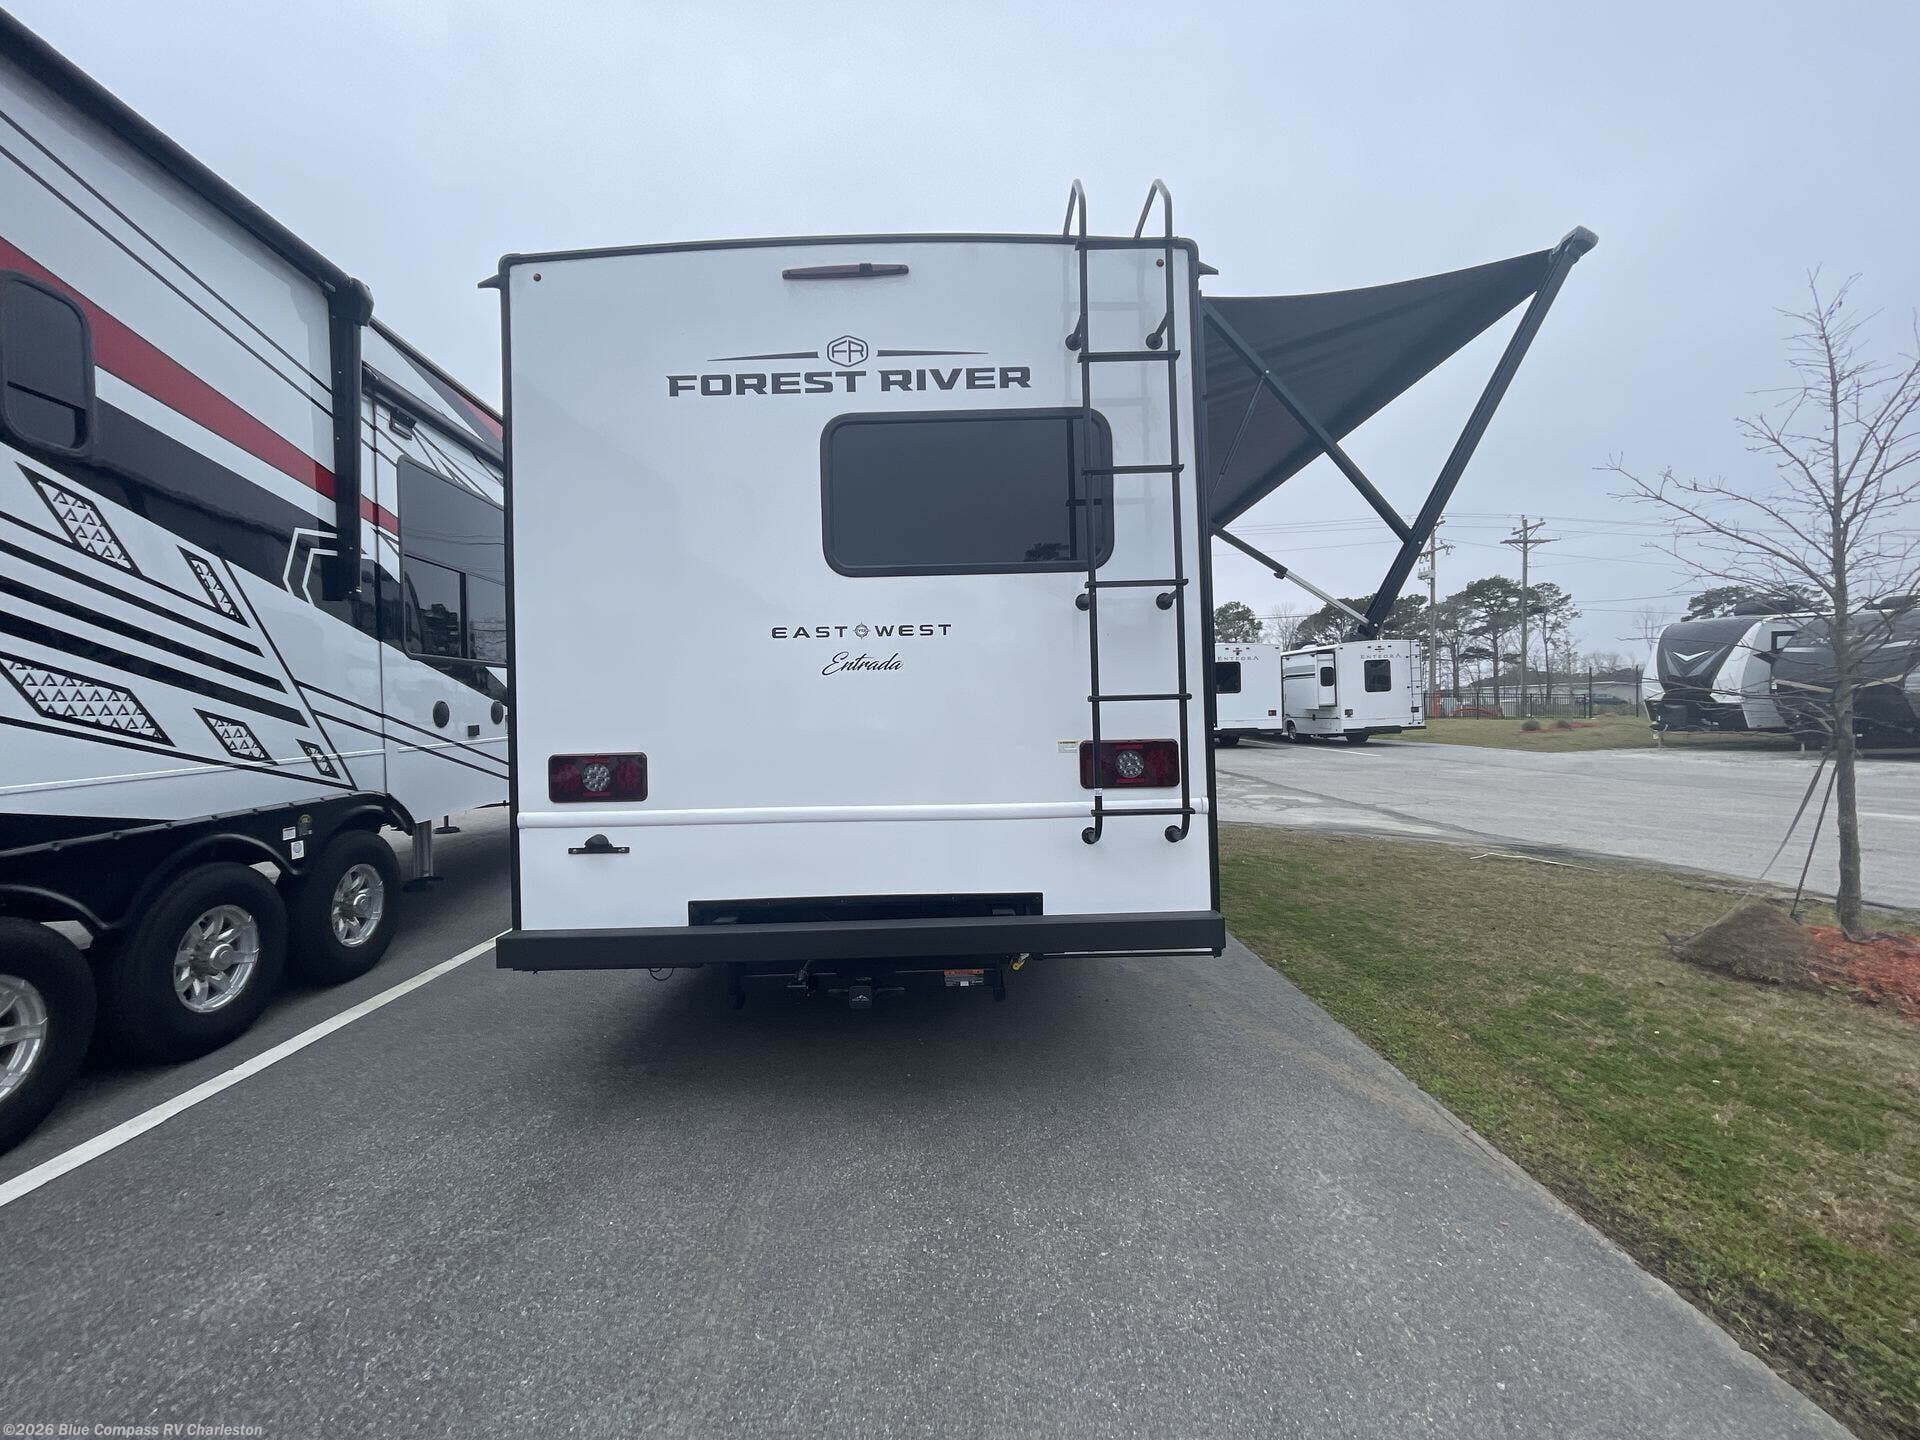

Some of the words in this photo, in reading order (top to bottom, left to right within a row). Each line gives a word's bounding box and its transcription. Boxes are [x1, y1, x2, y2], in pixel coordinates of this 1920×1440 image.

[665, 371, 867, 397] FOREST
[877, 366, 1032, 391] RIVER
[771, 626, 848, 639] EAST
[874, 624, 952, 638] WEST
[821, 651, 904, 676] Entrada
